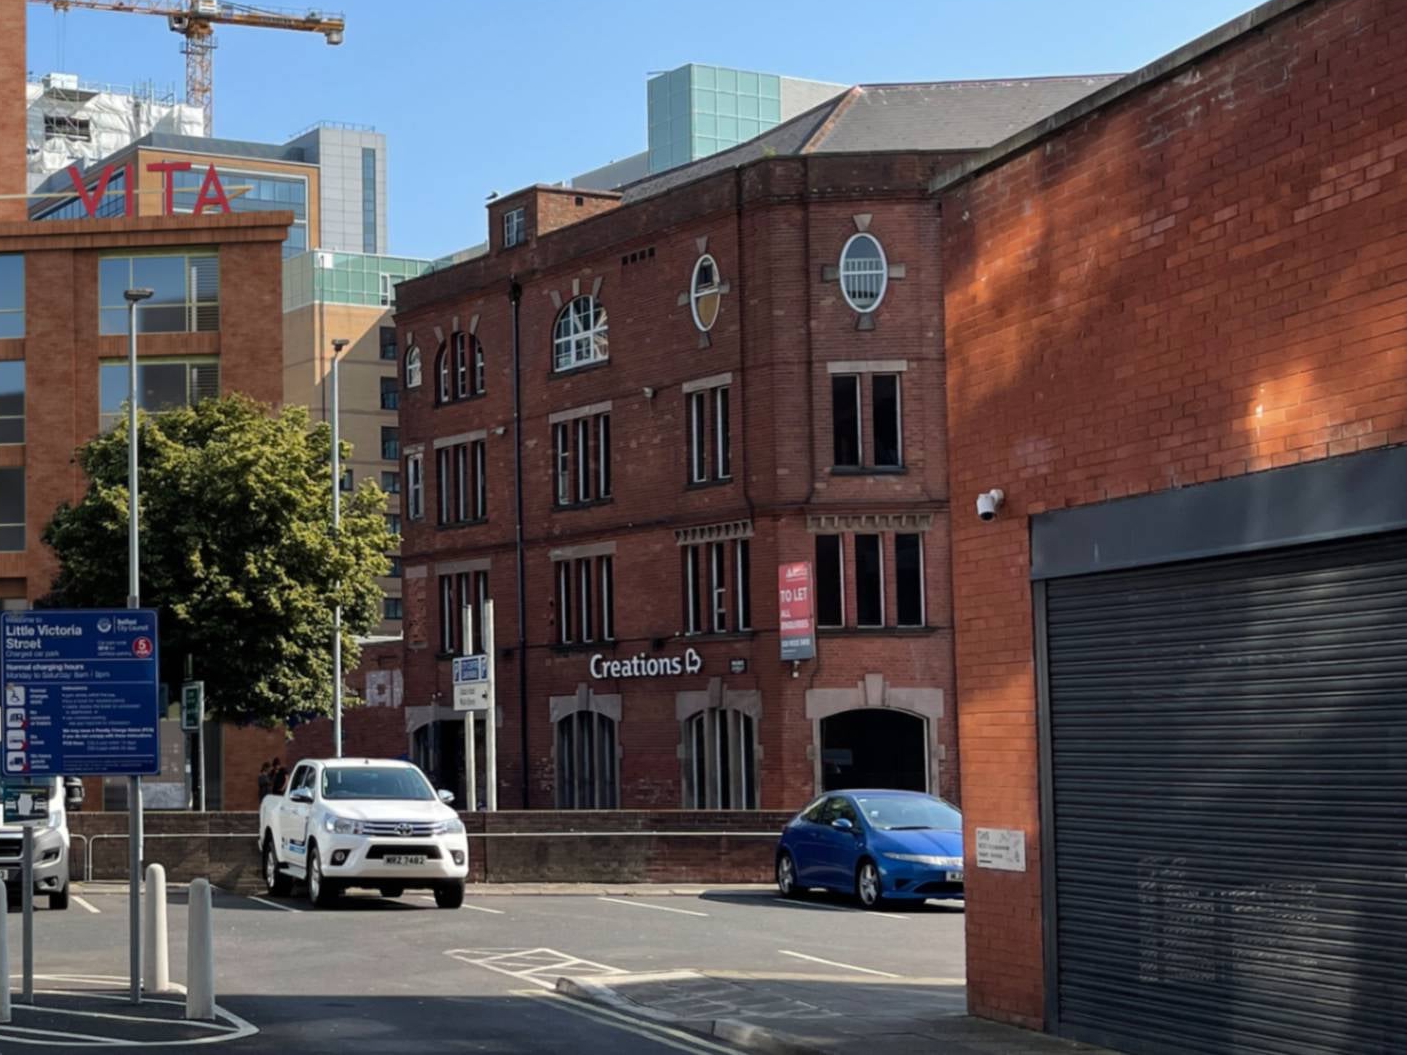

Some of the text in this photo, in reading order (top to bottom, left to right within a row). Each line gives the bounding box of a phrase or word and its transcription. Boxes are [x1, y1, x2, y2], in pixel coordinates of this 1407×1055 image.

[67, 162, 232, 218] VITA
[780, 587, 807, 602] TO LET
[6, 624, 83, 636] Little Victoria
[6, 638, 42, 649] Street
[138, 639, 146, 650] 5
[5, 650, 33, 658] Charged
[45, 650, 60, 658] park
[33, 663, 63, 671] charging
[590, 652, 682, 679] Creations
